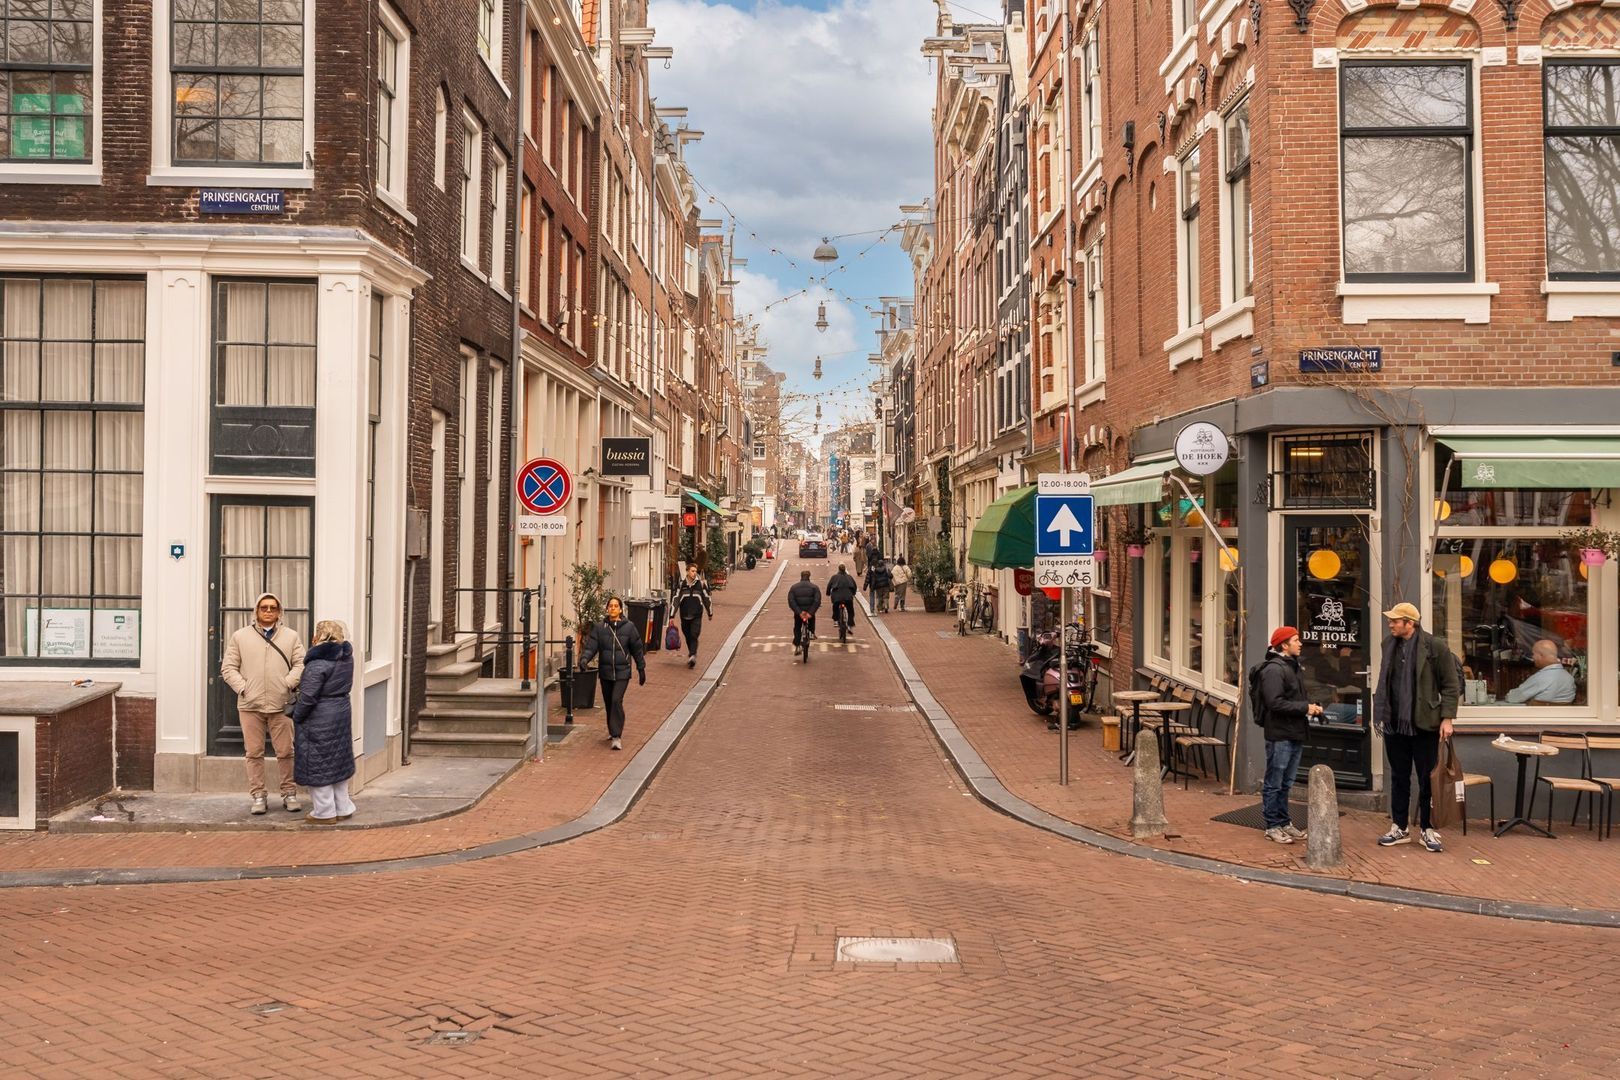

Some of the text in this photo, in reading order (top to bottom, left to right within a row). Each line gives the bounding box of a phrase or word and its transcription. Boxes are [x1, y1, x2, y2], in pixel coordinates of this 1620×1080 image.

[202, 191, 280, 203] PRINSENGRACHT
[1302, 350, 1378, 361] PRINSENGRACHT
[606, 447, 645, 460] bussia
[1040, 480, 1088, 488] 12.00-18.00h
[1039, 559, 1091, 567] uitgezonderd
[1302, 631, 1356, 642] DE HOEK
